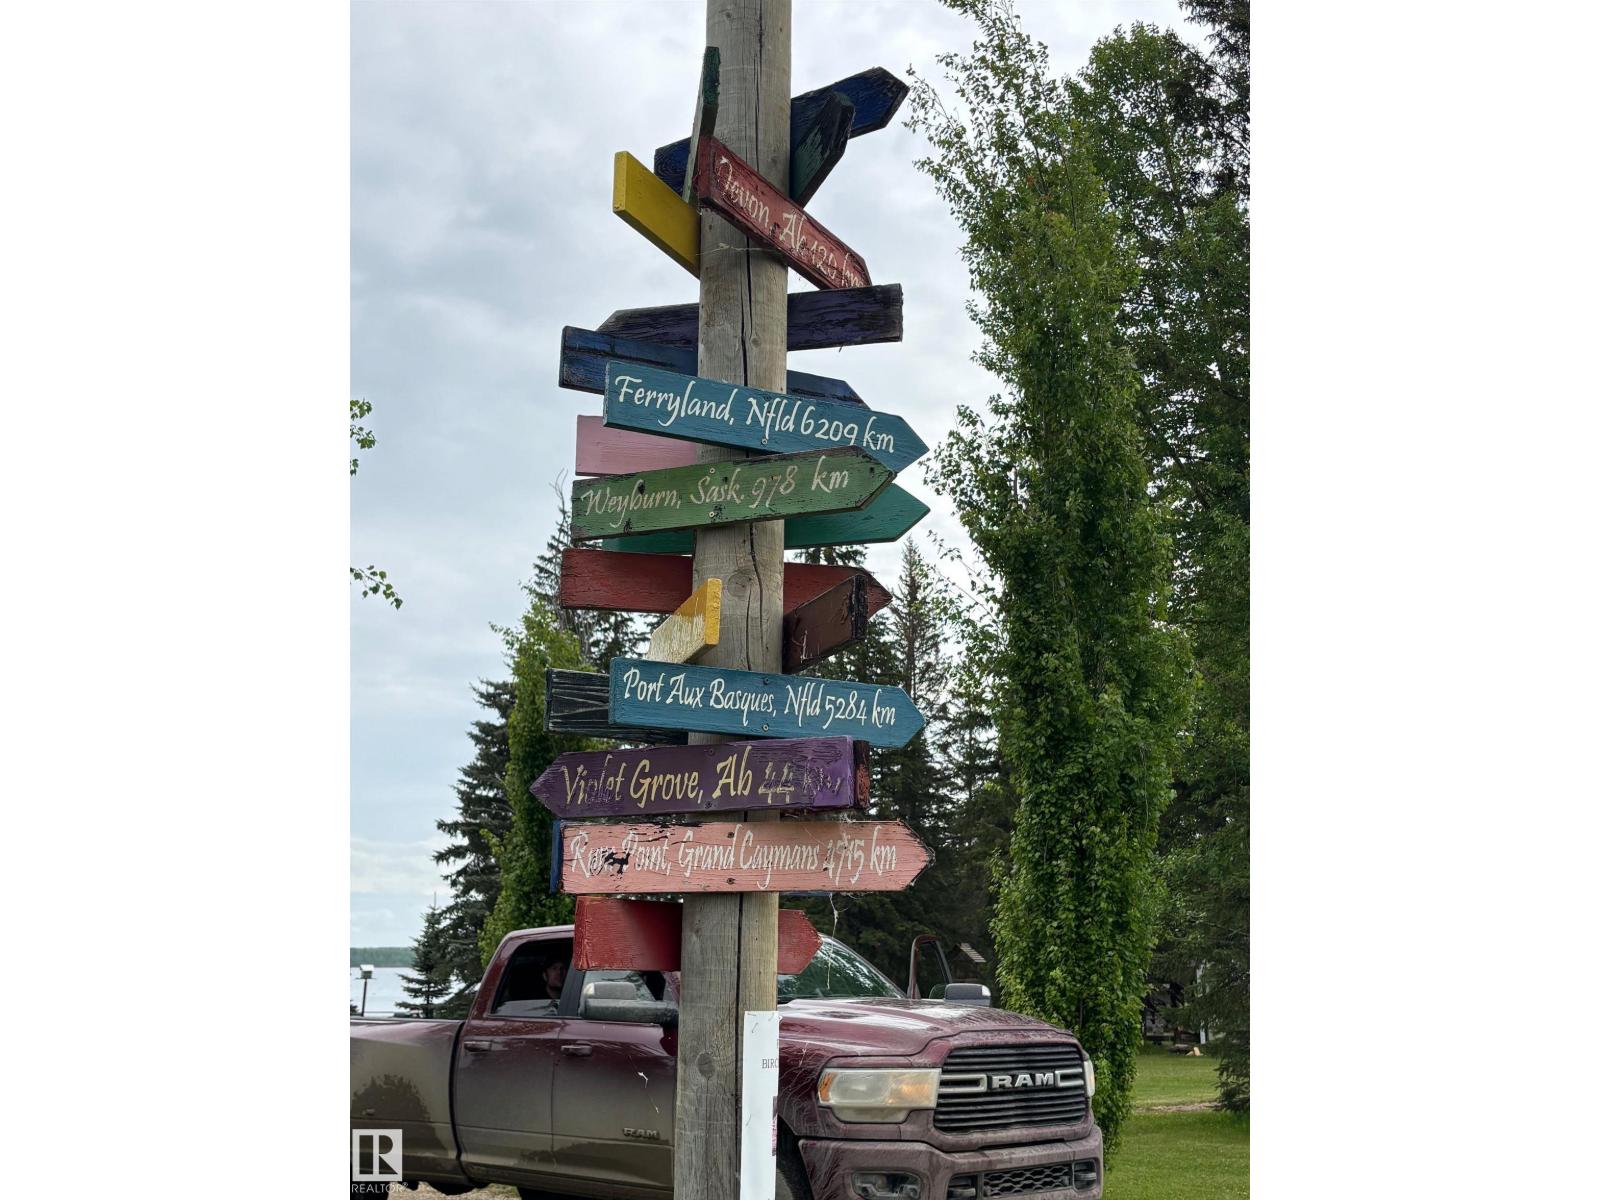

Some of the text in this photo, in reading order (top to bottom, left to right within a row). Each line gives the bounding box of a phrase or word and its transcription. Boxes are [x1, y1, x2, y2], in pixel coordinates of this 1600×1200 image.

[779, 211, 807, 252] Ab
[615, 375, 894, 454] Ferryland, Nfld 6209 km
[580, 454, 849, 528] Weyburn, Sask. 978 km
[623, 667, 896, 730] Port Aux Basques, Nfld 5284 km
[559, 753, 627, 805] Violet
[629, 758, 704, 809] Grove,
[711, 745, 753, 799] Ab
[758, 761, 795, 805] 44
[621, 830, 672, 877] Point,
[678, 823, 744, 878] Grand
[739, 829, 819, 890] Caymans
[869, 825, 897, 876] km
[990, 1072, 1054, 1088] RAM
[623, 1127, 660, 1139] RAM
